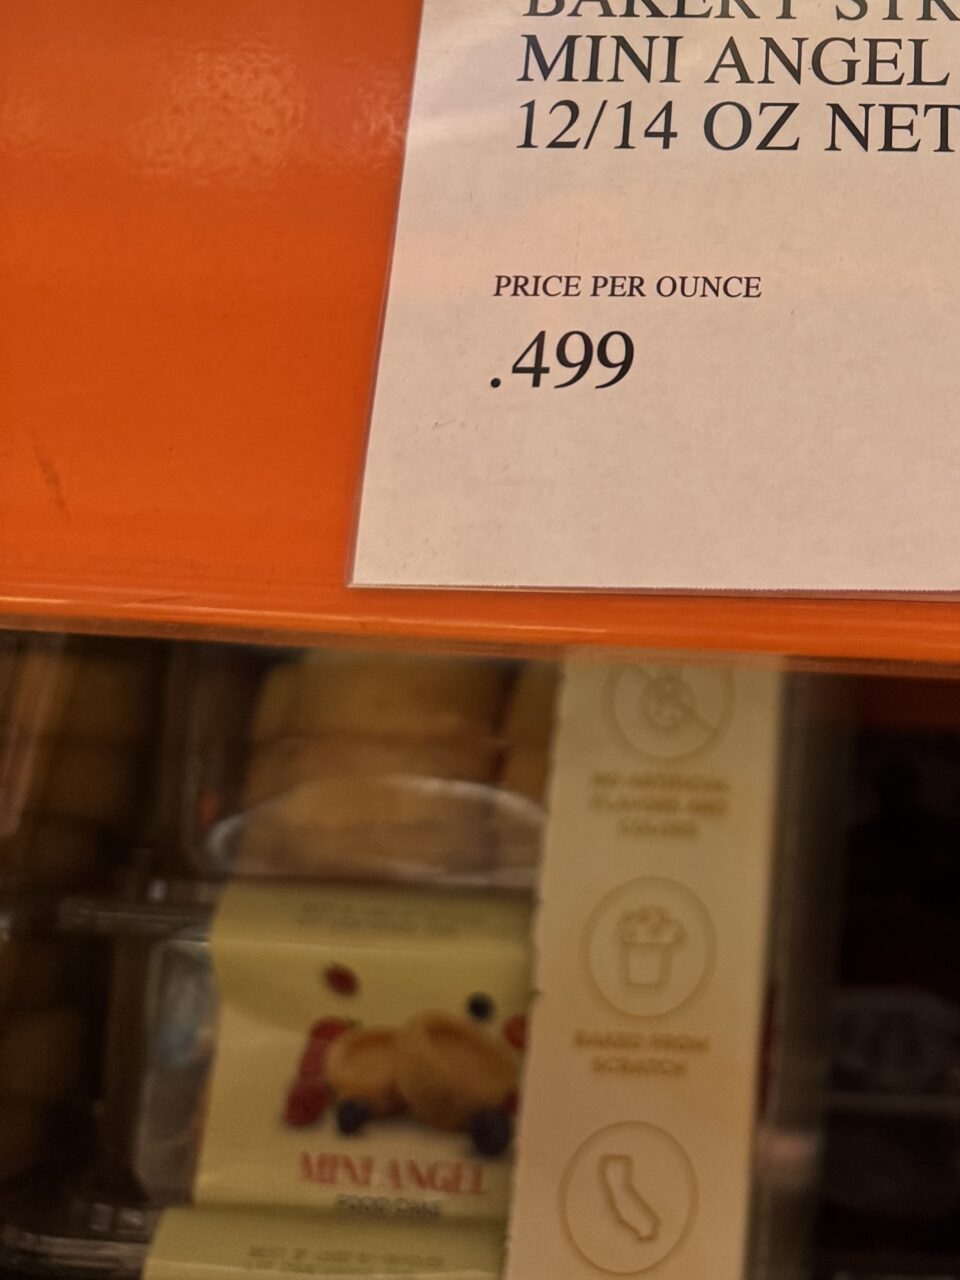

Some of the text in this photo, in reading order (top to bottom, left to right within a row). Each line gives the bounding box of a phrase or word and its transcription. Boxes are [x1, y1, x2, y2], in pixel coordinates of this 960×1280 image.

[516, 34, 684, 84] MINI
[703, 36, 951, 87] ANGEL
[516, 99, 678, 151] 12/14
[703, 101, 800, 152] OZ
[492, 274, 763, 298] PRICE PER OUNCE
[489, 330, 636, 390] .499
